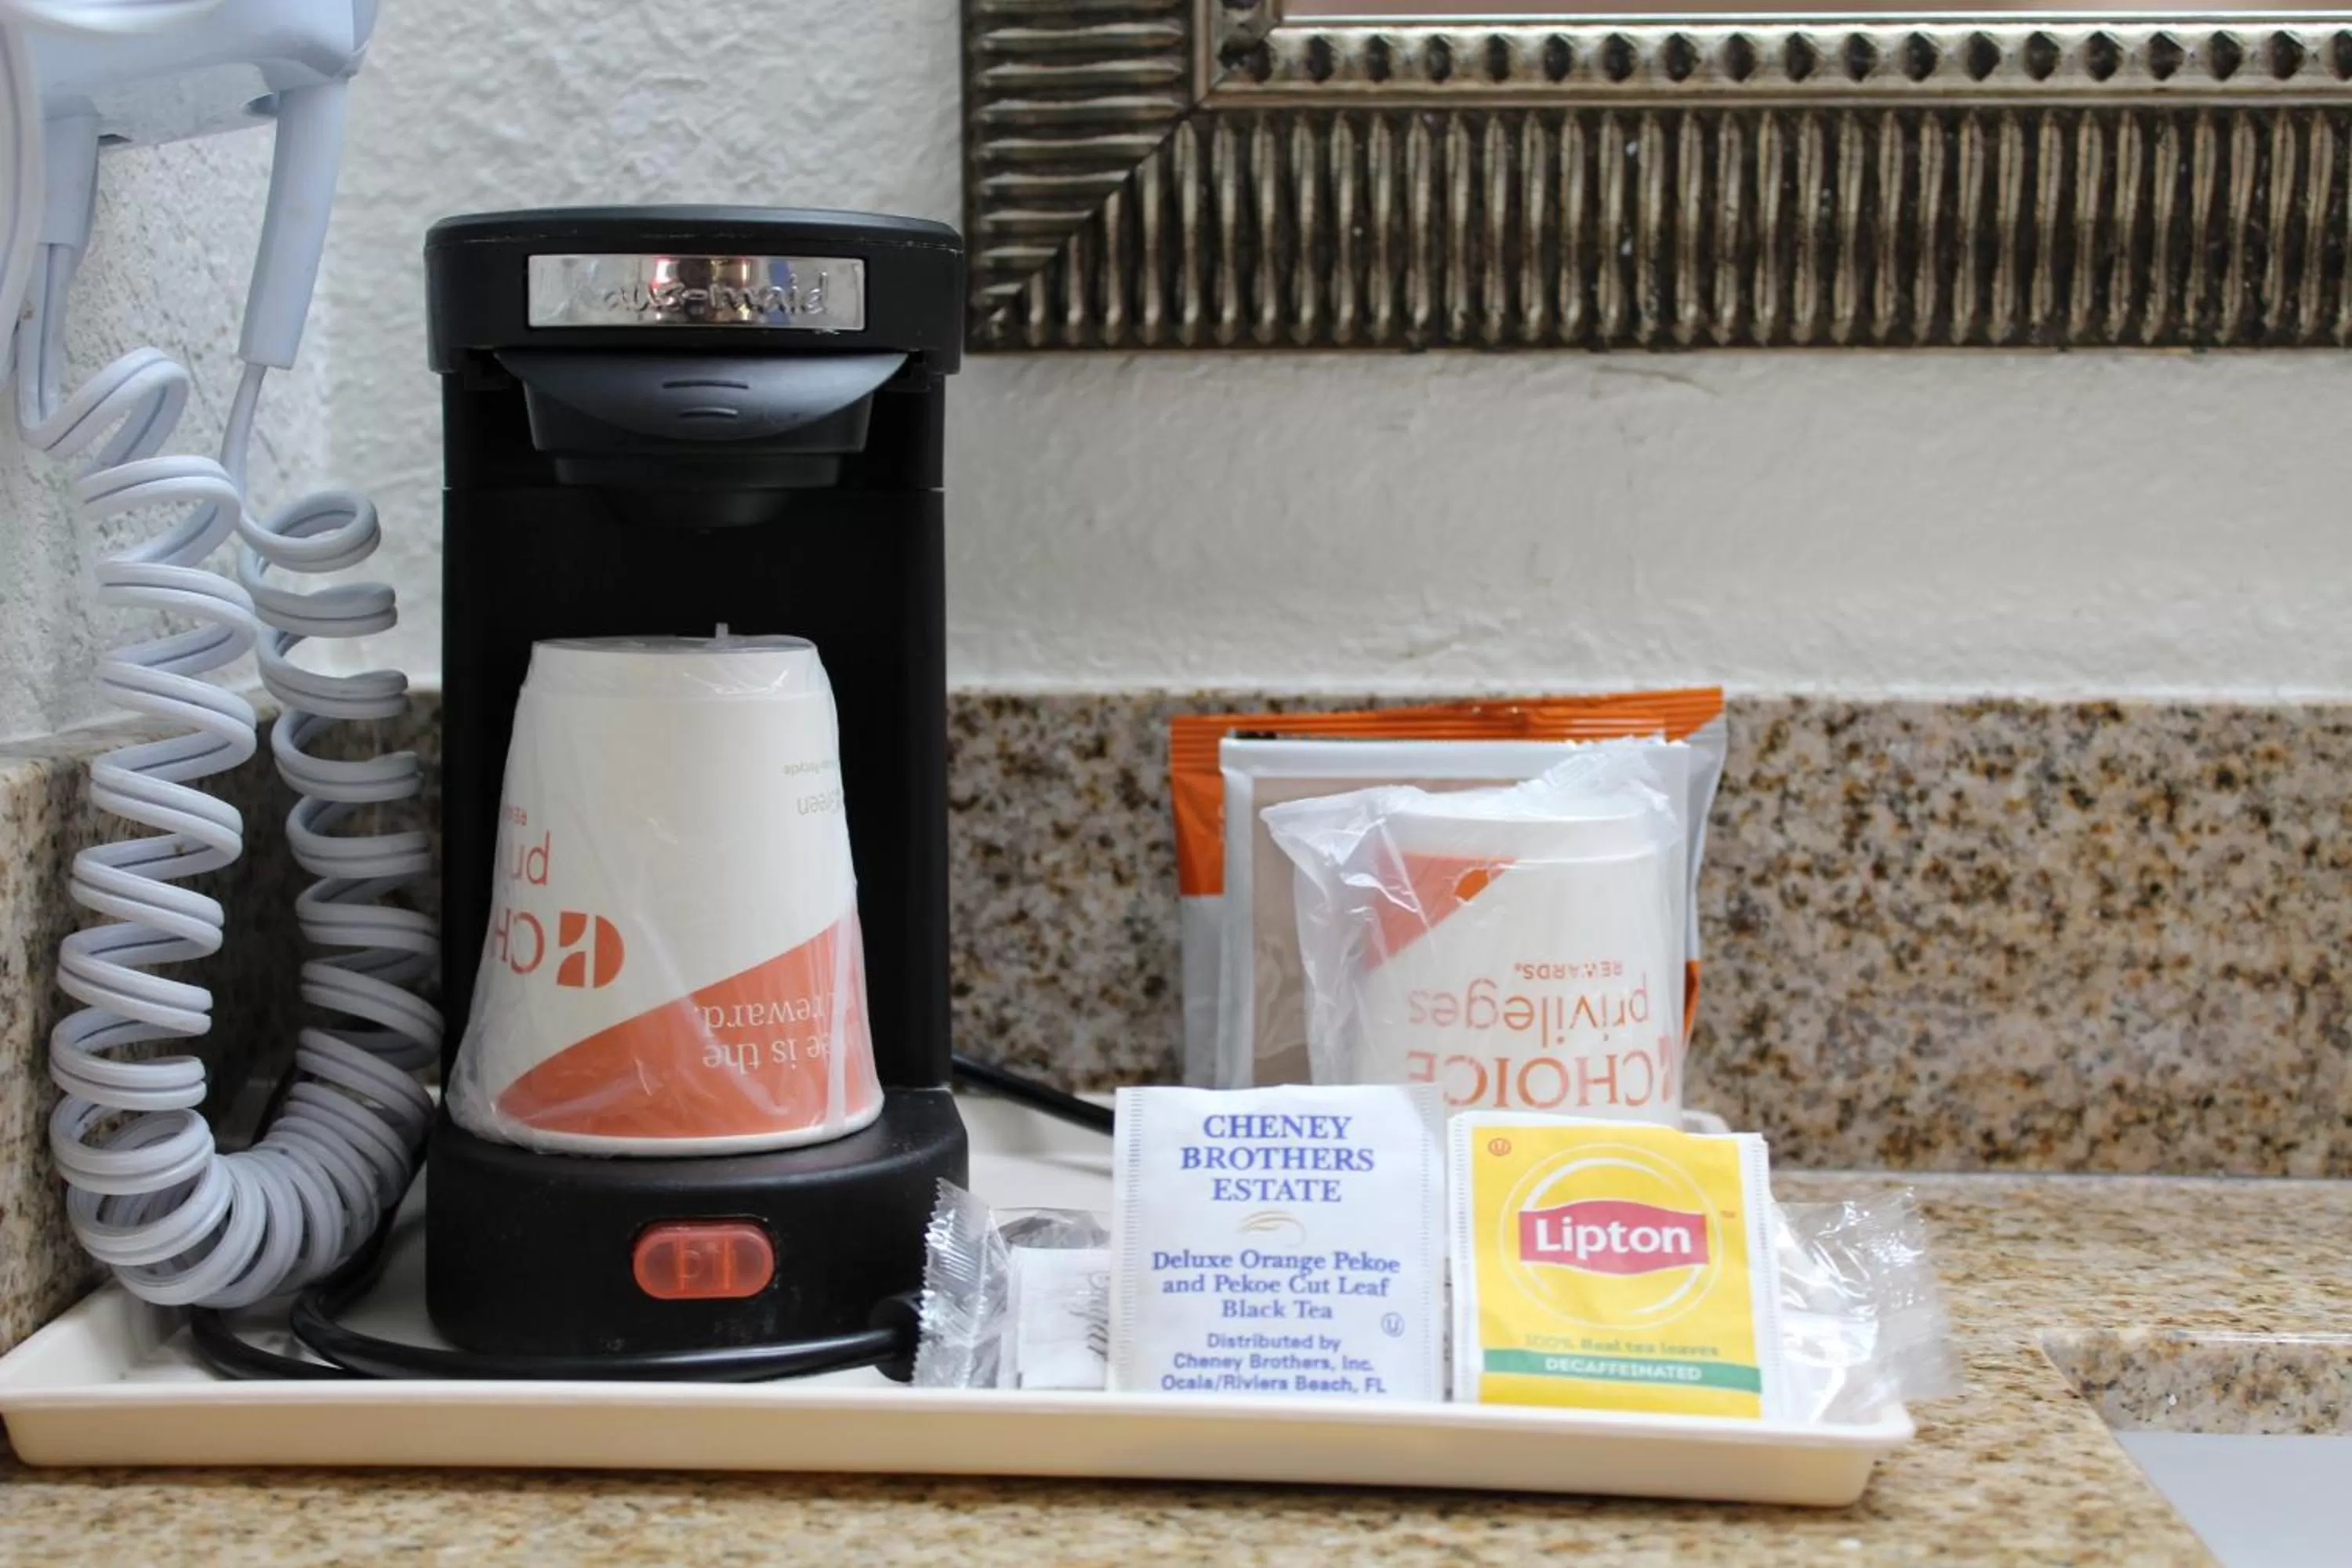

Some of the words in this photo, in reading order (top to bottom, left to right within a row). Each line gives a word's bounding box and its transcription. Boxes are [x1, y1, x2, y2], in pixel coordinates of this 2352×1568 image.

[1407, 972, 1650, 1048] privileges
[702, 1044, 761, 1075] the
[771, 1038, 797, 1069] is
[1406, 1050, 1655, 1109] CHOICE
[1203, 1114, 1353, 1139] CHENEY
[1180, 1146, 1375, 1172] BROTHERS
[1210, 1178, 1341, 1203] ESTATE
[1535, 1216, 1692, 1261] Lipton
[1152, 1249, 1233, 1270] Deluxe
[1240, 1249, 1327, 1276] Orange
[1333, 1251, 1400, 1273] Pekoe
[1162, 1274, 1205, 1294] and
[1214, 1274, 1281, 1293] Pekoe
[1289, 1275, 1330, 1294] Cut
[1338, 1276, 1390, 1296] Leaf
[1221, 1298, 1286, 1318] Black
[1294, 1301, 1334, 1319] Tea
[1207, 1333, 1314, 1349] Distributed
[1319, 1334, 1342, 1352] by
[1173, 1353, 1243, 1370] Cheney
[1544, 1357, 1702, 1381] DECAFFEINATED
[1365, 1377, 1387, 1392] FL
